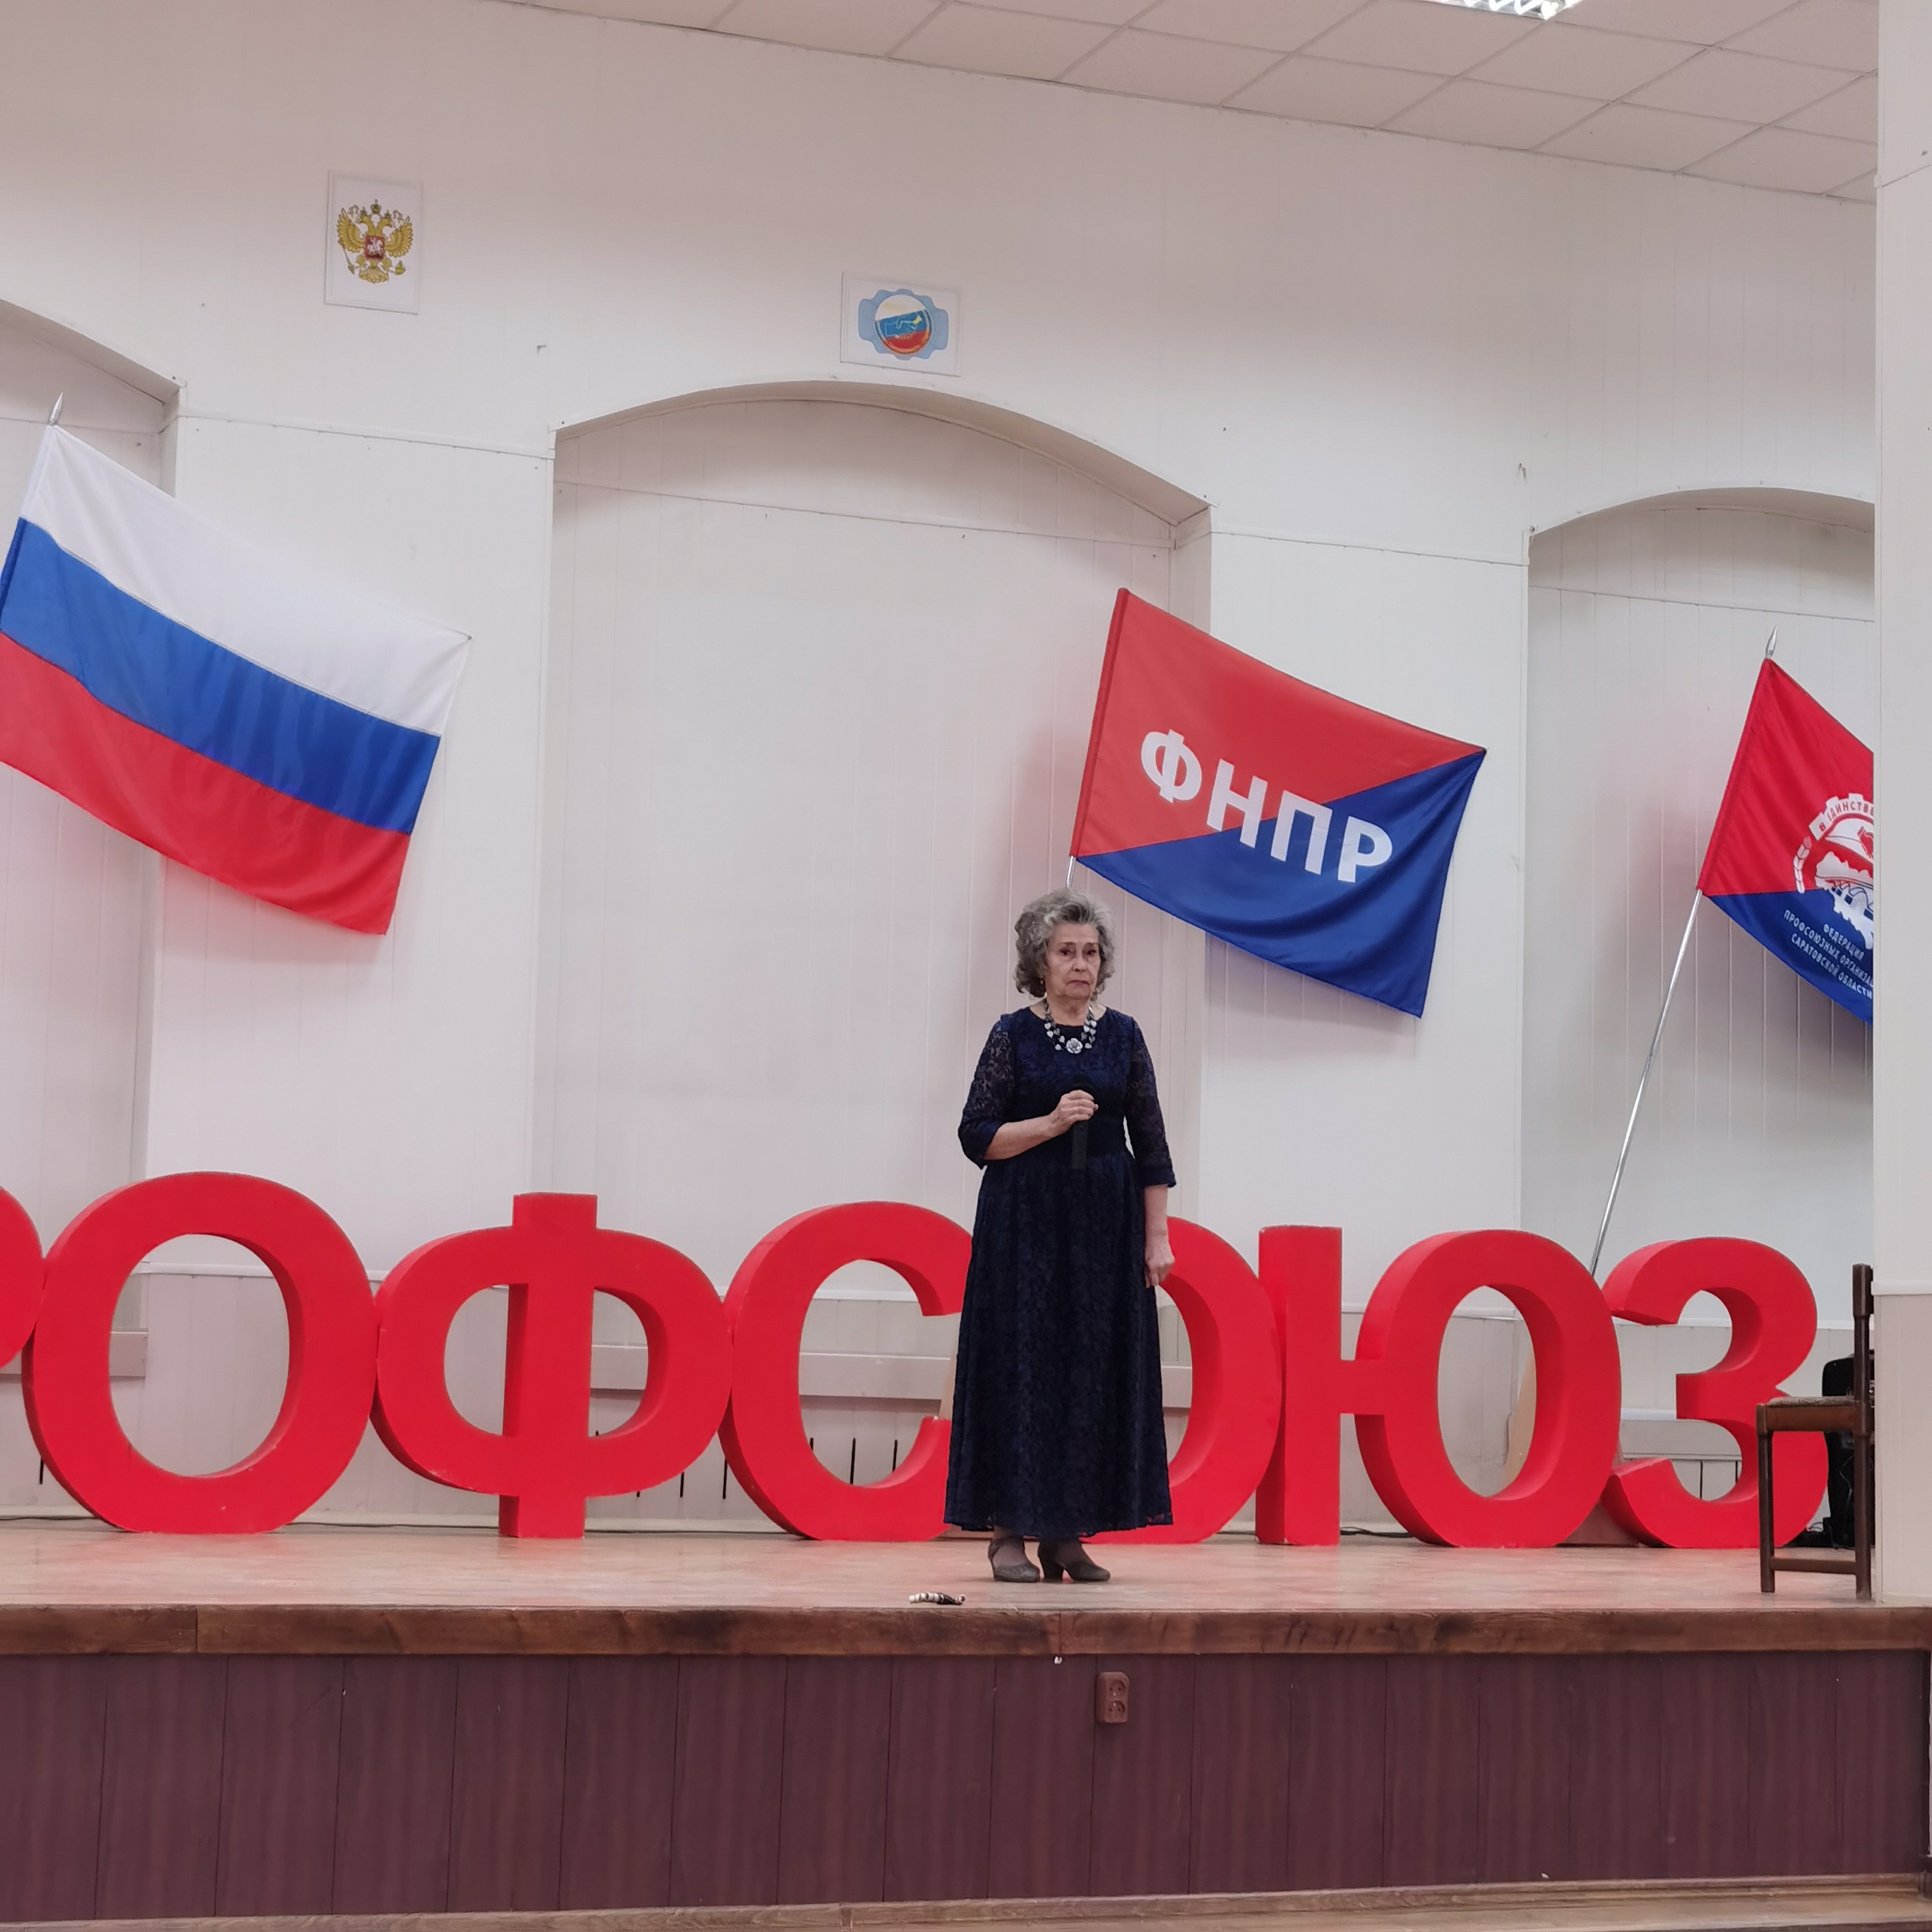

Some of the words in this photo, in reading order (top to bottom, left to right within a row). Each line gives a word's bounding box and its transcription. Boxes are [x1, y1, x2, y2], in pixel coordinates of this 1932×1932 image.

[1140, 729, 1393, 883] ФНПР
[1784, 910, 1841, 960] ПРОФСОЮЗНЫХ
[1791, 933, 1841, 977] САРАТОВСКОЙ
[1838, 972, 1873, 1000] ОБЛАСТИ
[1823, 924, 1865, 961] ФЕДЕРАЦИЯ
[0, 1171, 1829, 1549] ОФСЮЗ
